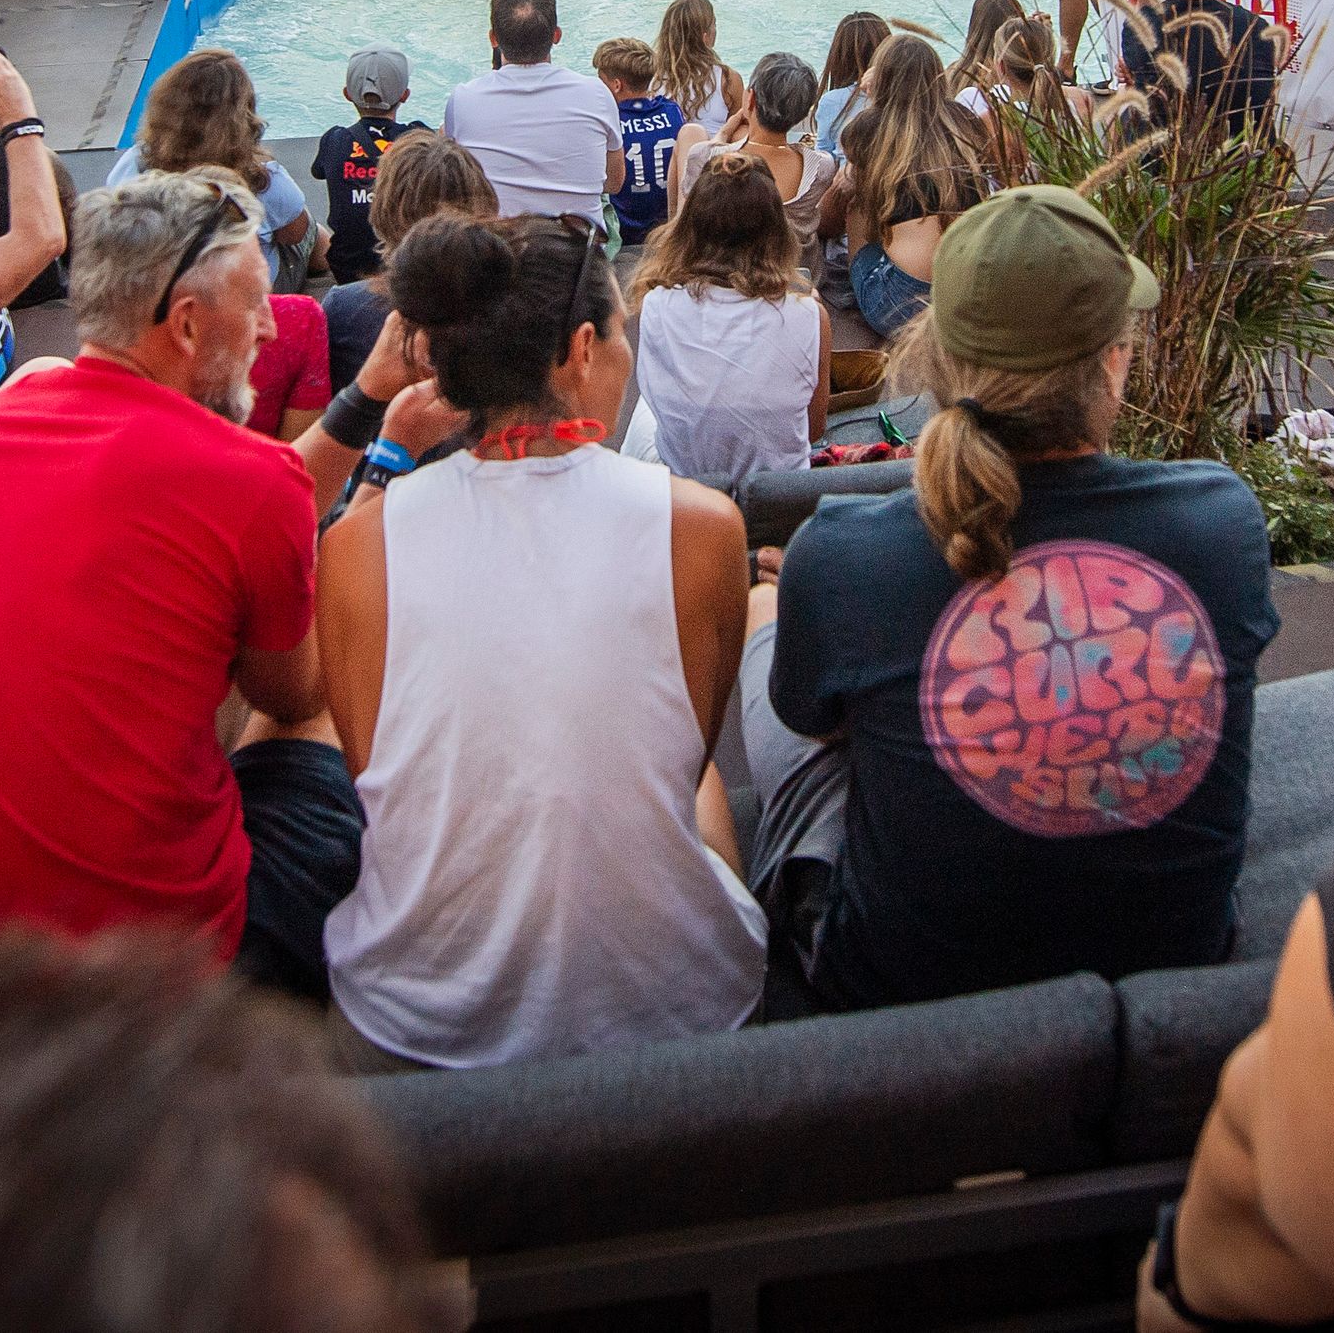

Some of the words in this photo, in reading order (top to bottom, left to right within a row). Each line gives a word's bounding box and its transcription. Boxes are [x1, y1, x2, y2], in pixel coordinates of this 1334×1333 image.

[620, 113, 672, 135] MESSI
[947, 556, 1165, 670] RIP
[942, 611, 1214, 739] CURL
